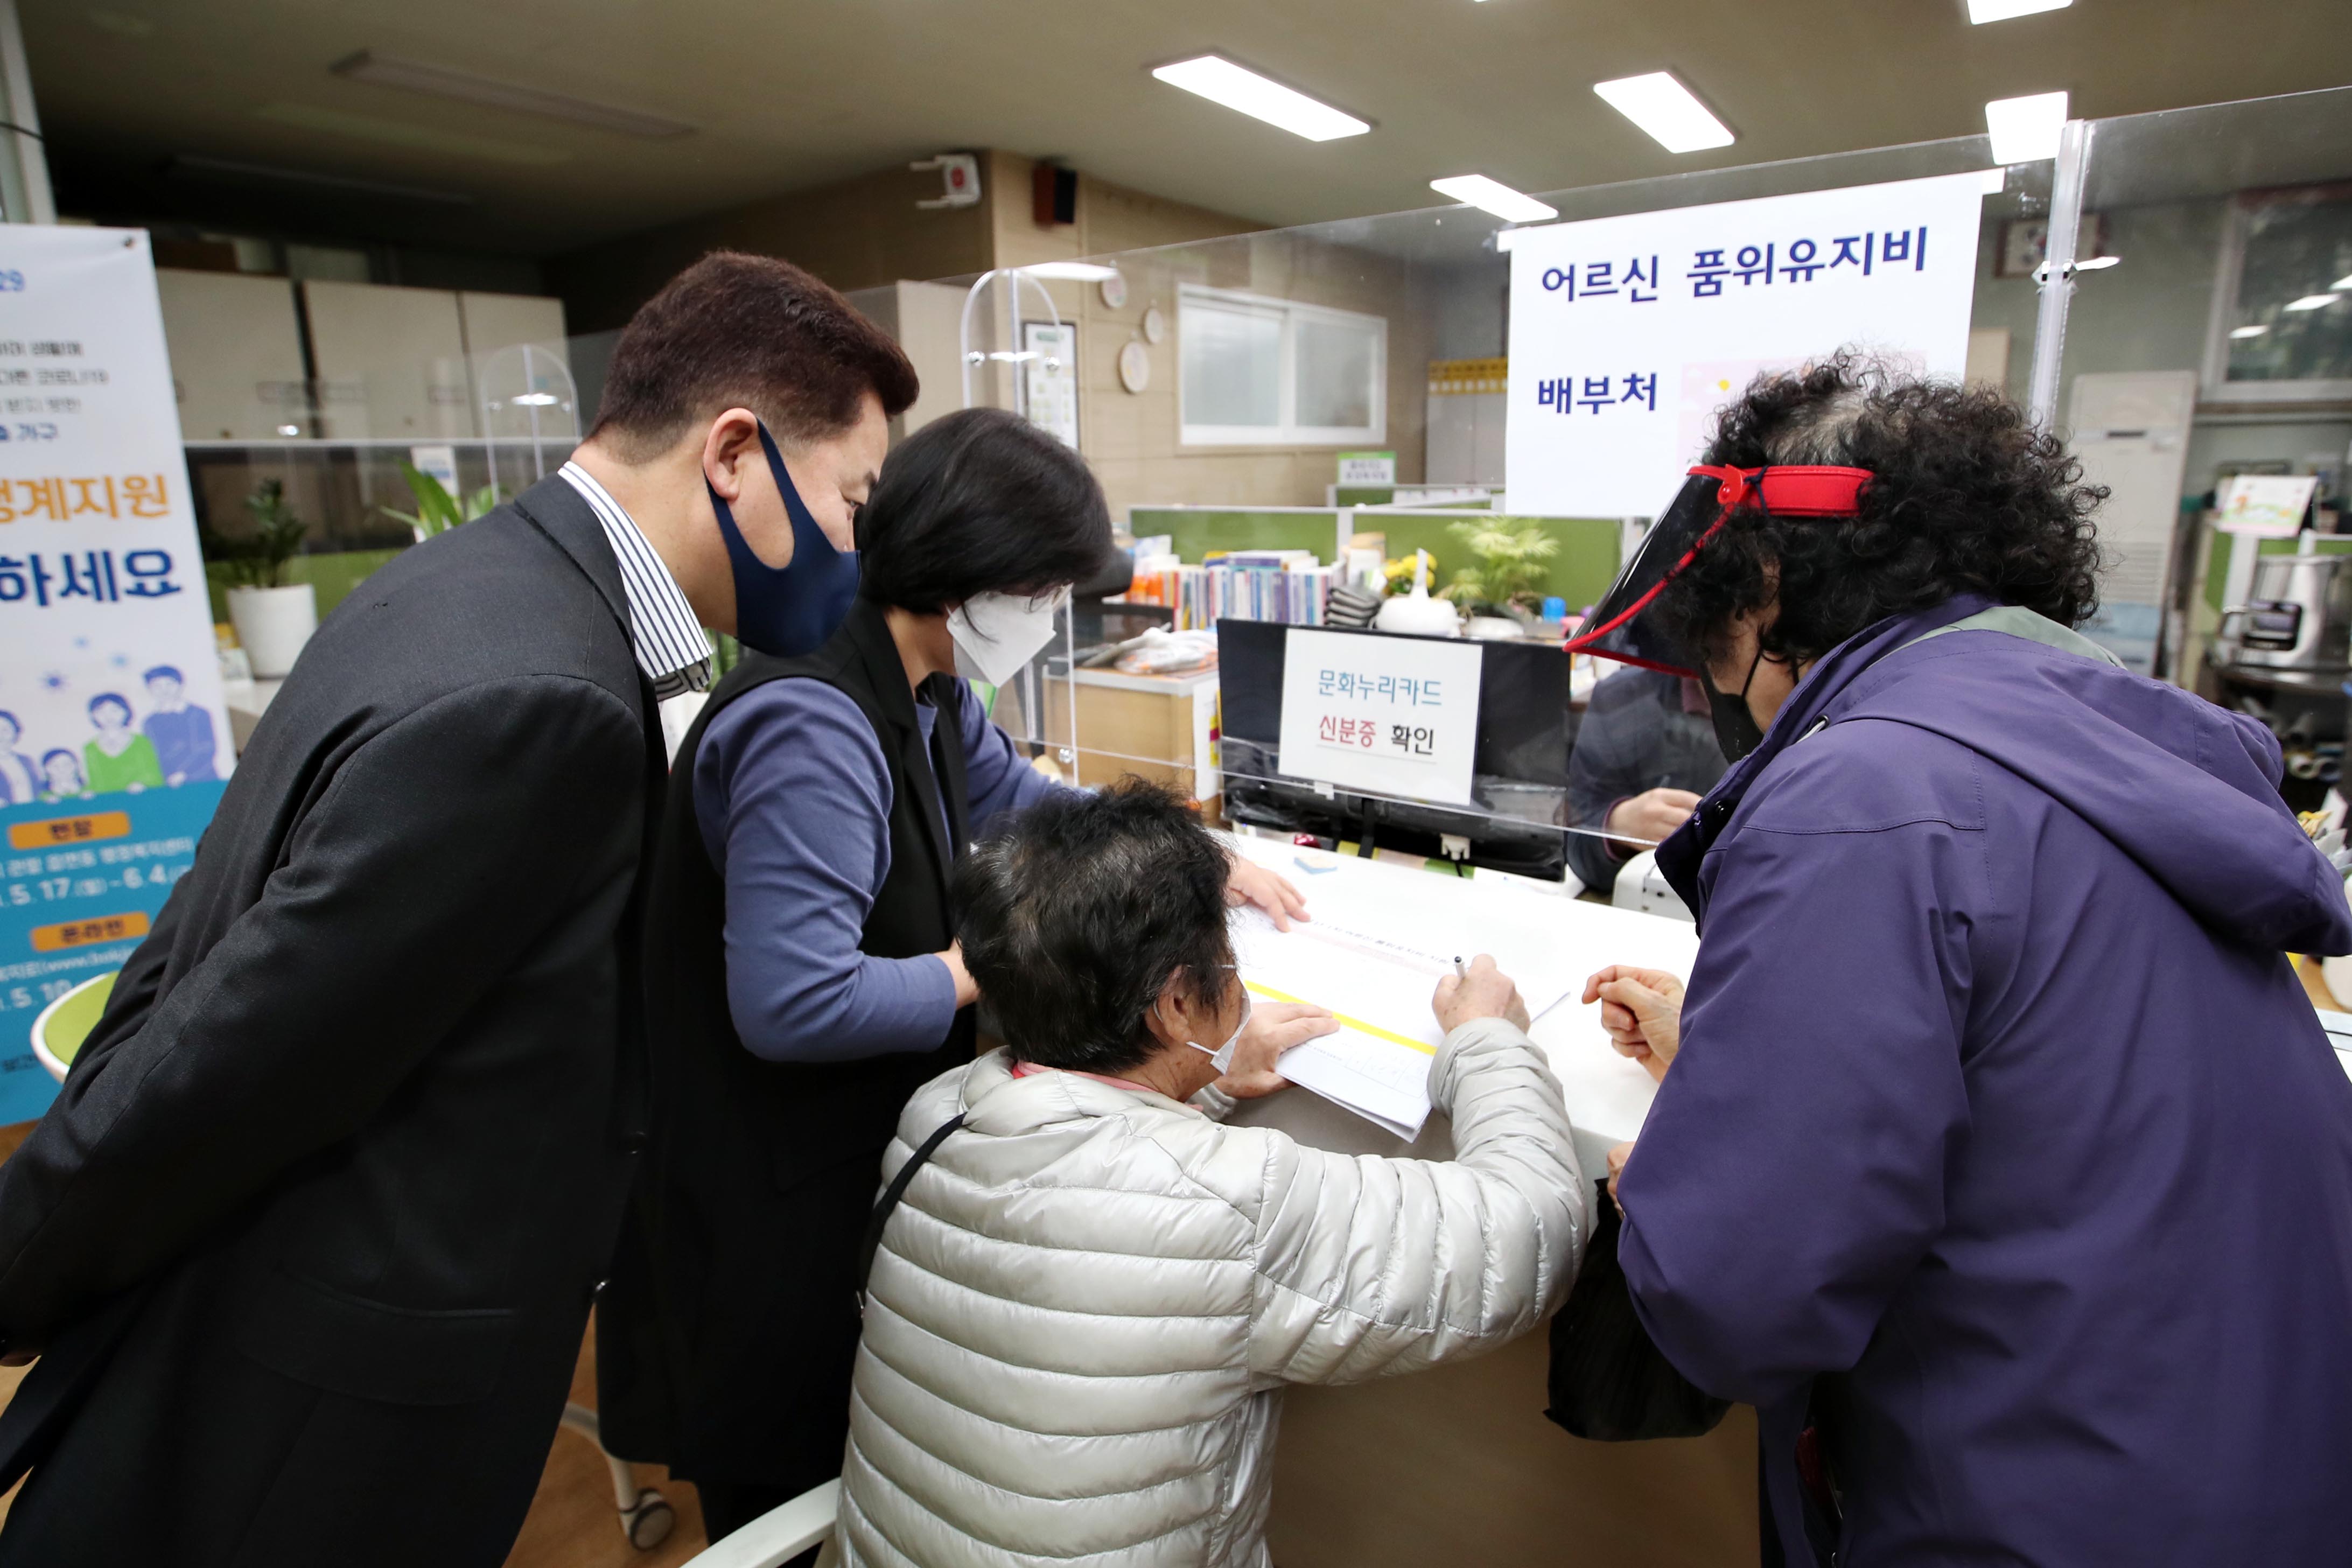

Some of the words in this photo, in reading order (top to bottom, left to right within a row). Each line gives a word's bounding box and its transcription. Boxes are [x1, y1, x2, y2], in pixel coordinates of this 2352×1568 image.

[1542, 255, 1659, 303] 어르신
[1686, 226, 1928, 299] 품위유지비
[1538, 372, 1657, 415] 배부처
[0, 548, 181, 607] 하세요
[1318, 669, 1442, 706] 문화누리카드
[1319, 715, 1376, 748] 신분증
[1390, 724, 1434, 755] 확인
